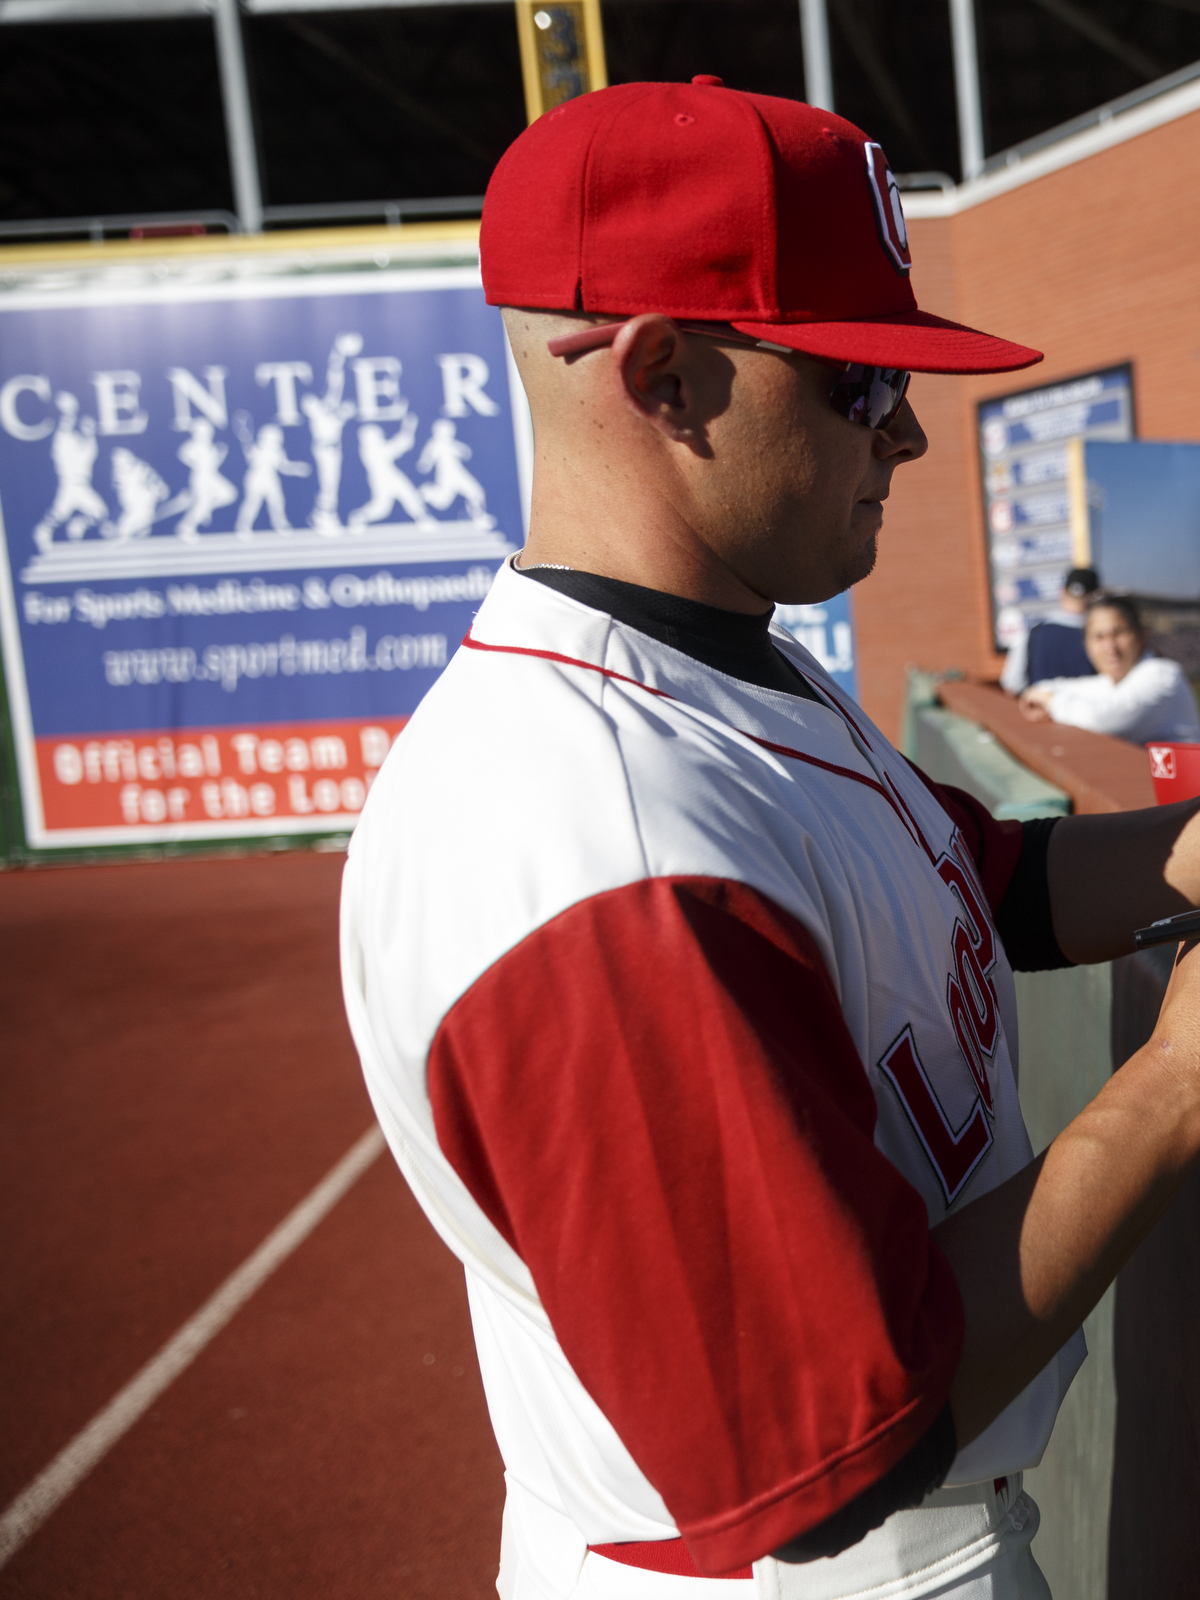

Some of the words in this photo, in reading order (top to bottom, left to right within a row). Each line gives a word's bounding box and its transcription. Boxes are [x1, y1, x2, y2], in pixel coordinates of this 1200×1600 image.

[0, 352, 500, 442] CENTER
[23, 591, 71, 625] For
[74, 588, 165, 630] Sports
[166, 578, 301, 615] Medicine
[302, 576, 331, 610] &
[329, 565, 496, 612] Orthopaedi
[102, 624, 448, 693] www.sportmed.com
[53, 735, 222, 785] Official
[230, 731, 348, 775] Team
[120, 782, 190, 824] for
[201, 776, 277, 819] the
